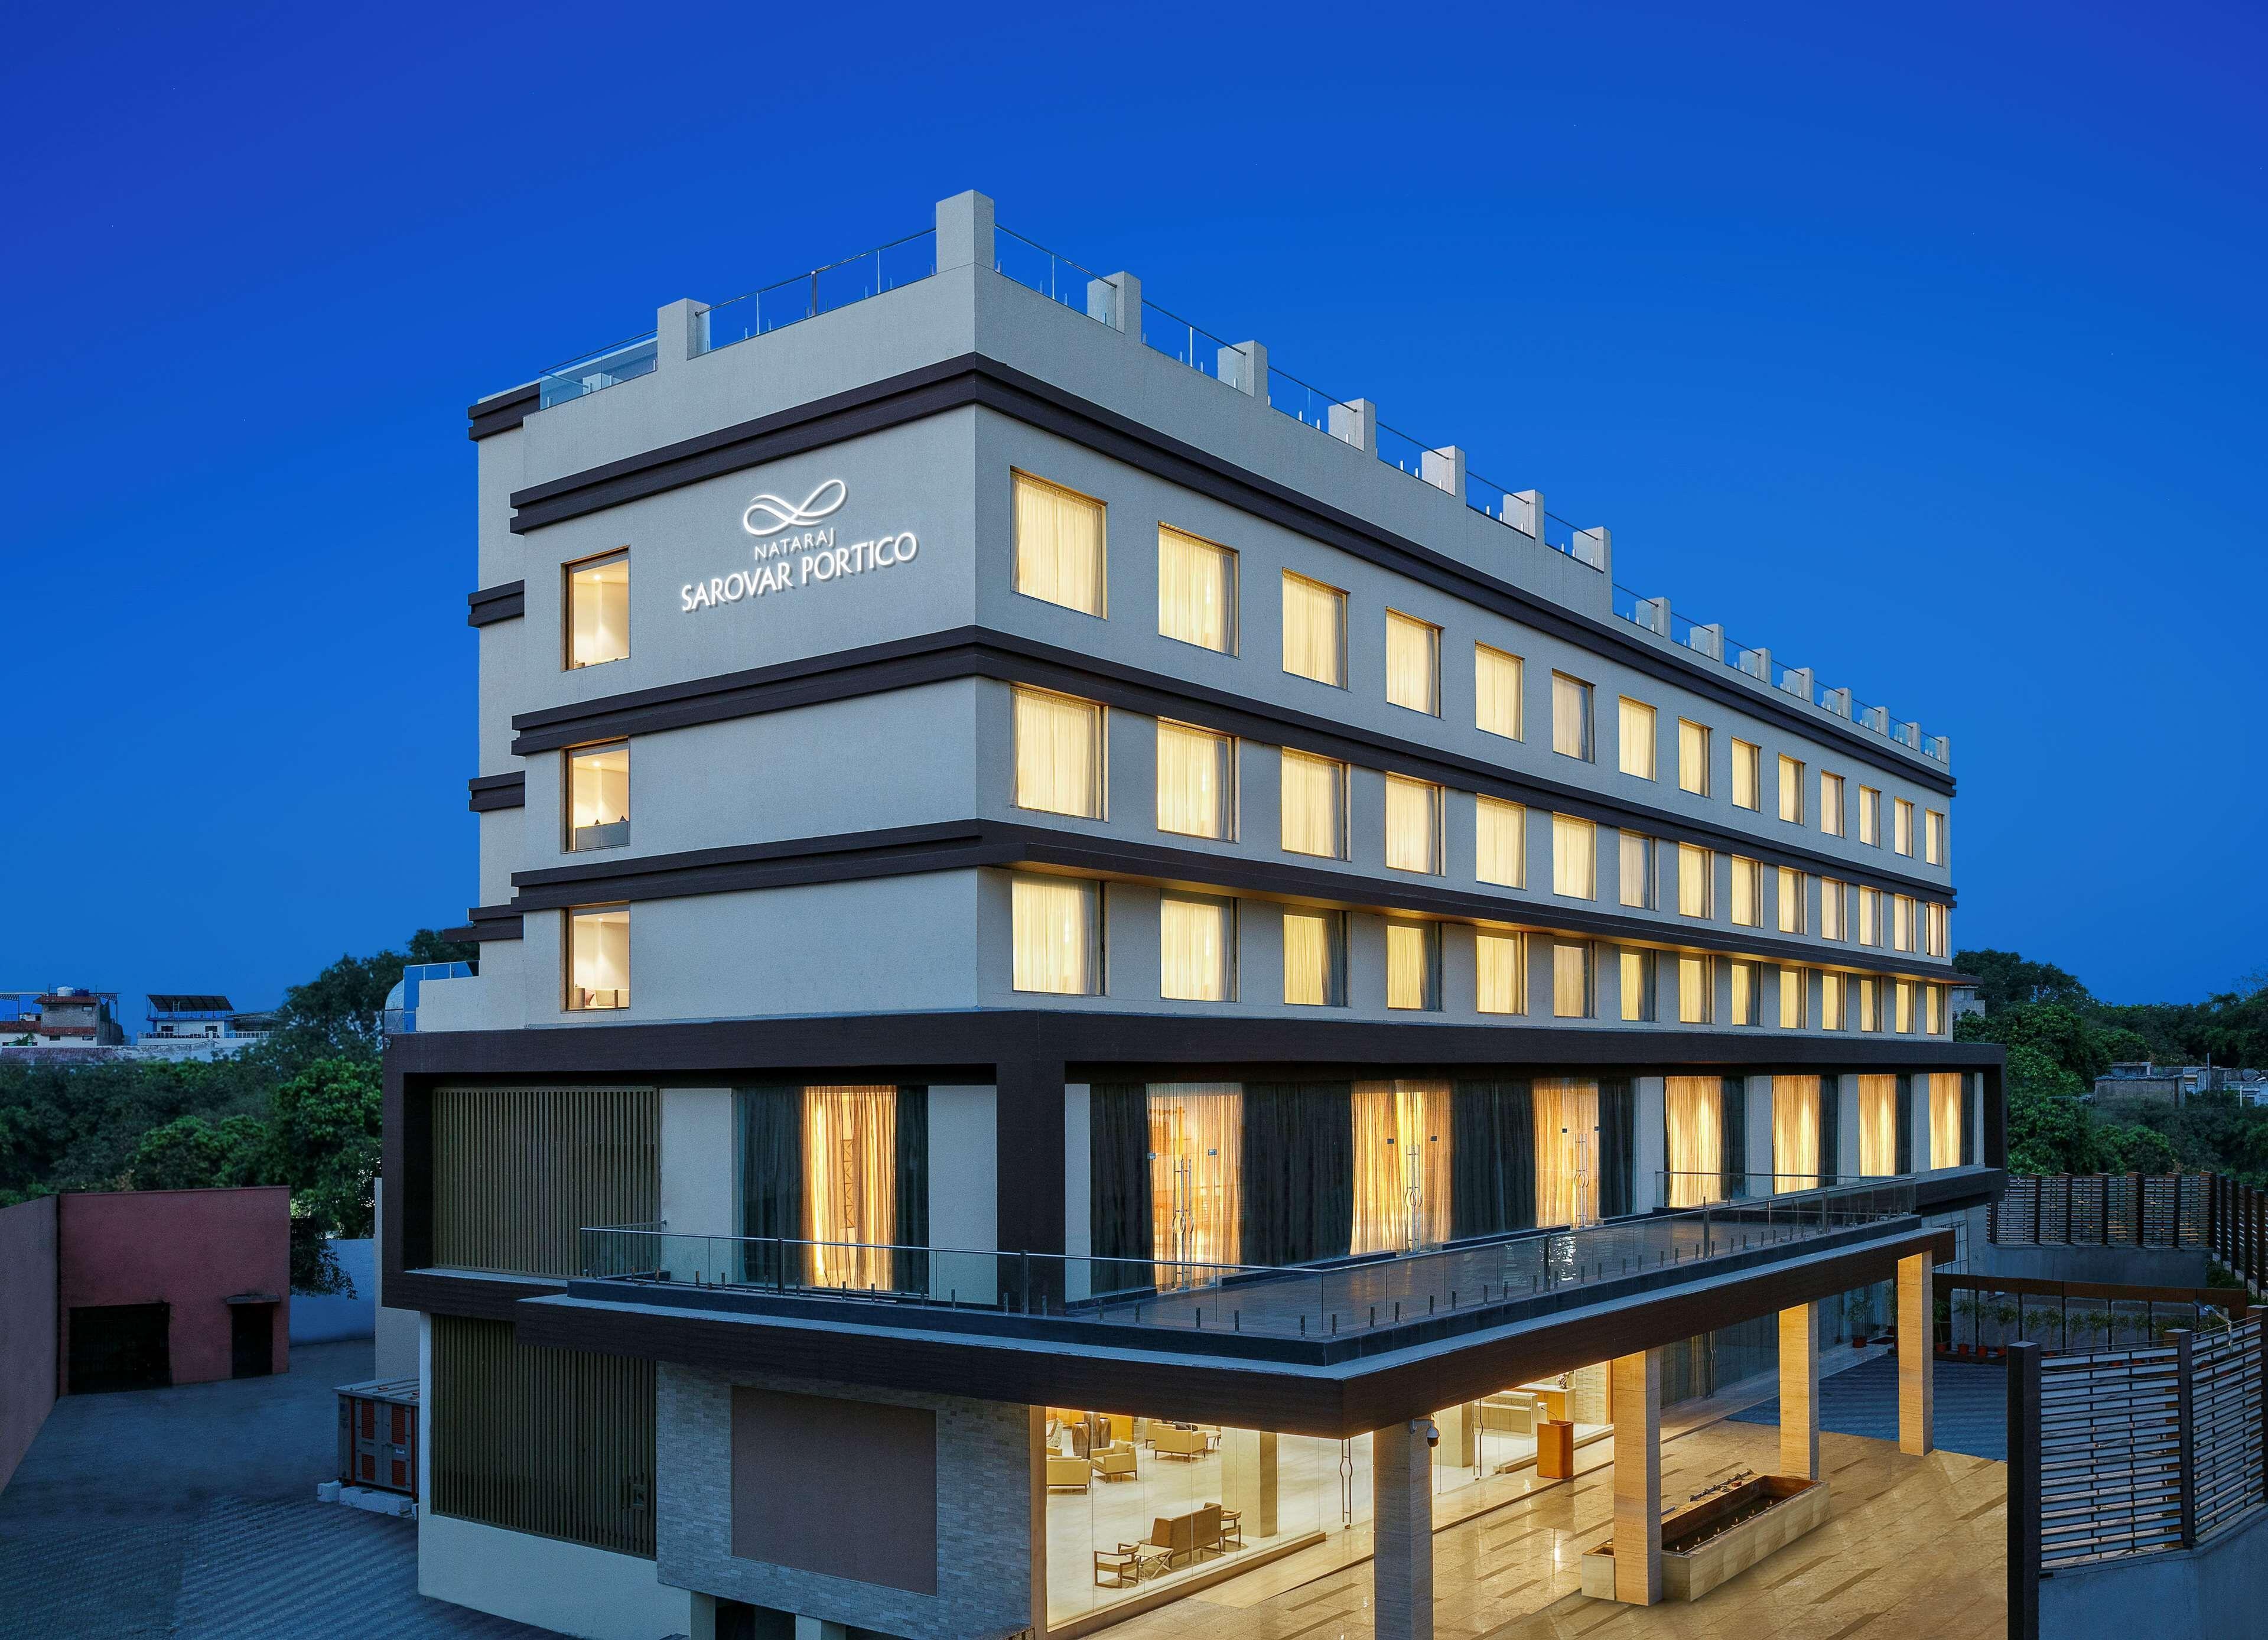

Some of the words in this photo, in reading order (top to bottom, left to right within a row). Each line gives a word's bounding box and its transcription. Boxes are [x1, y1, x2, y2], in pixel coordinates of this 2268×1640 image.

[681, 562, 793, 611] SAROVAR
[802, 532, 917, 584] PORTICO
[754, 527, 834, 561] NATARAJ
